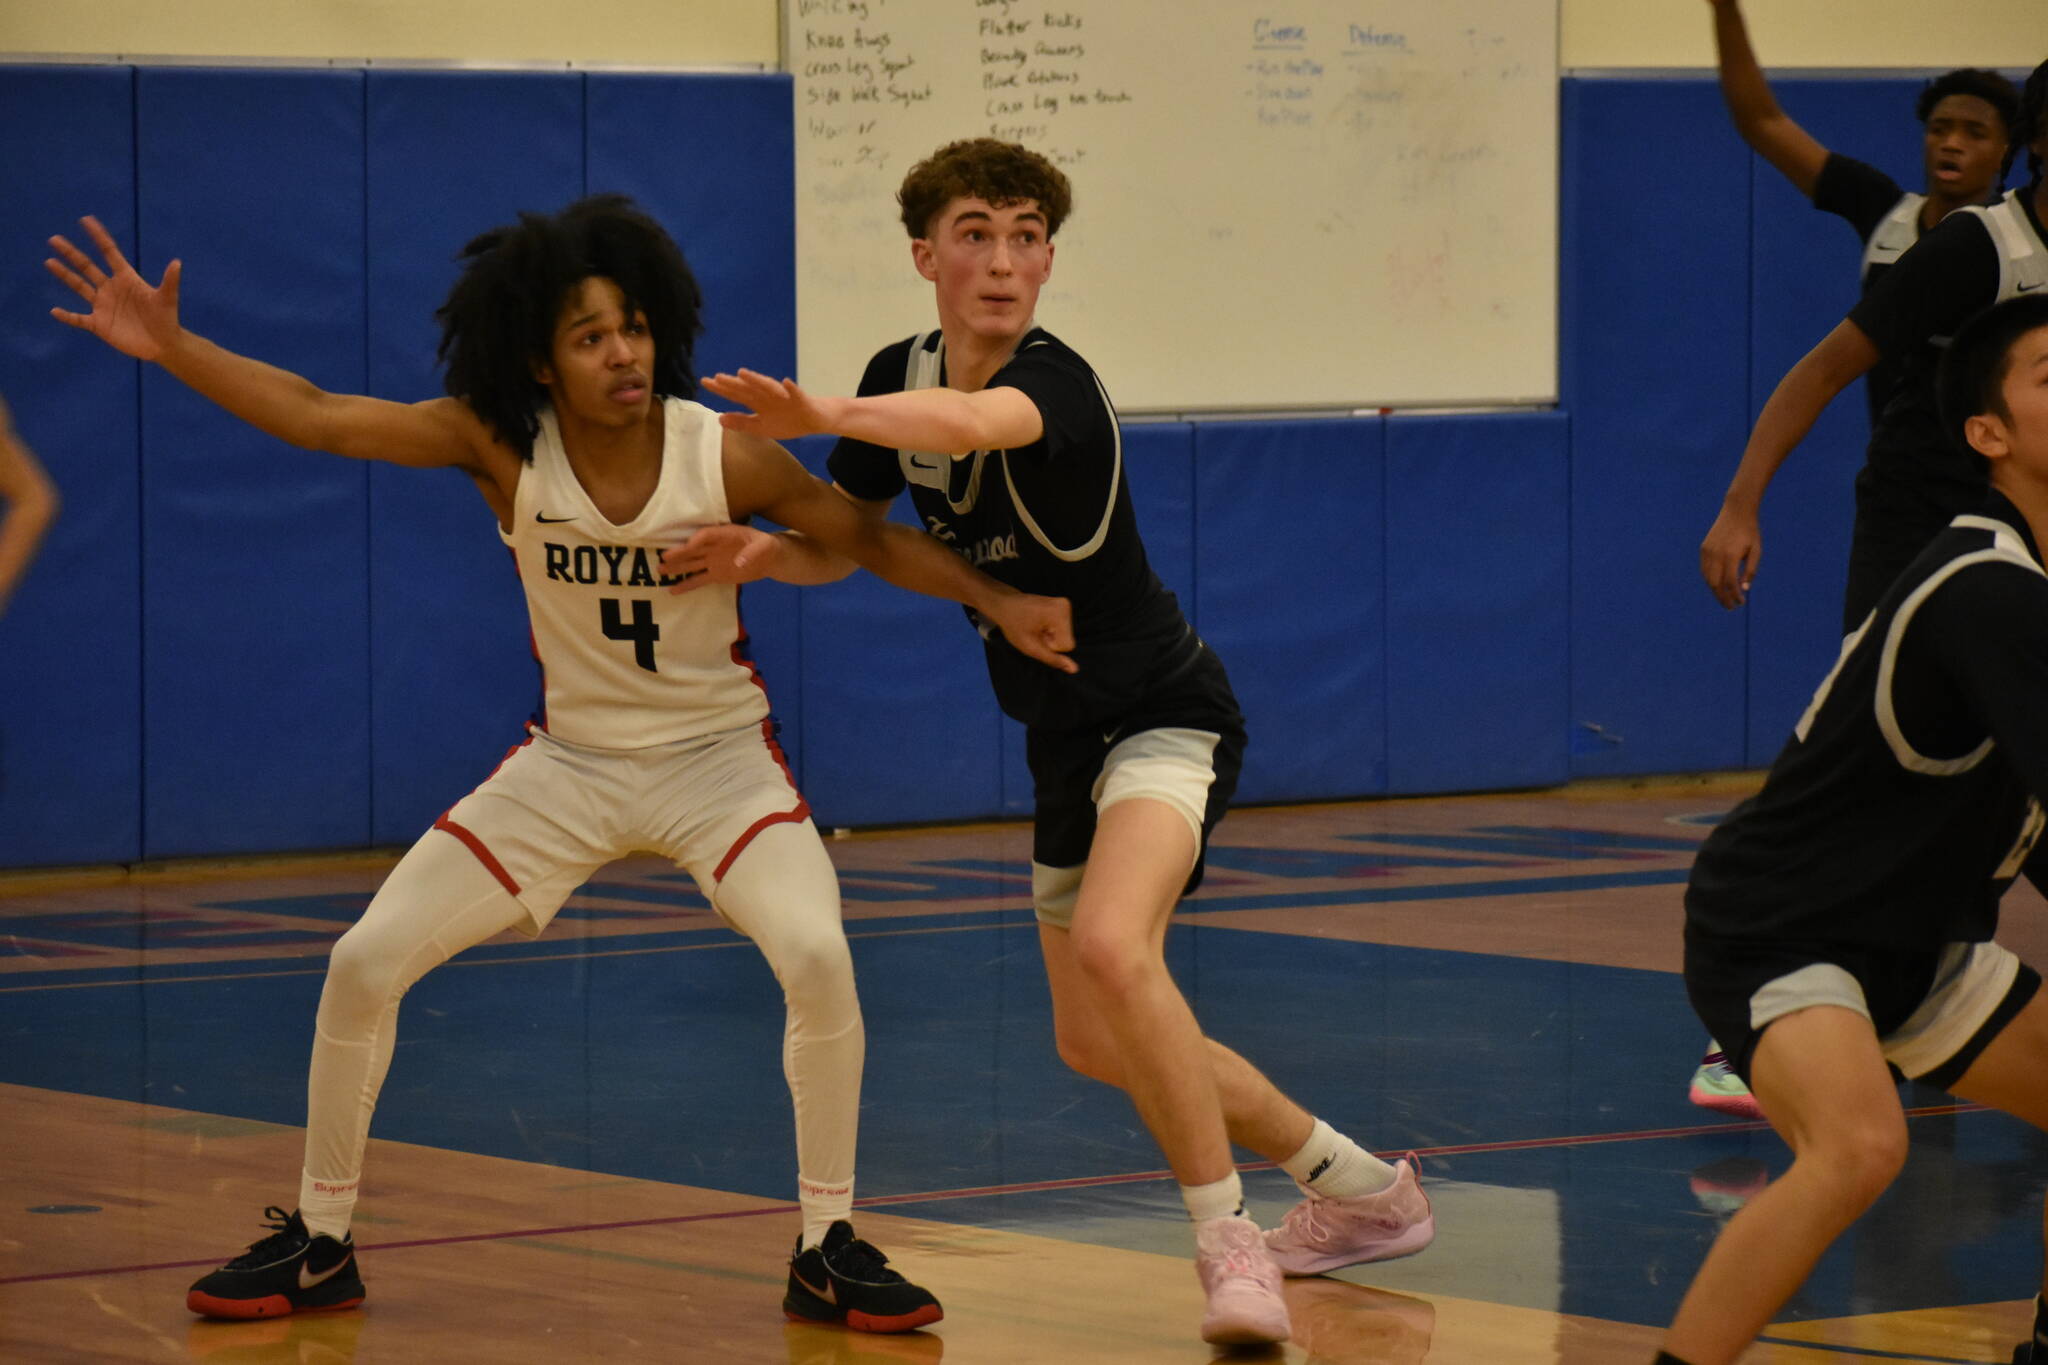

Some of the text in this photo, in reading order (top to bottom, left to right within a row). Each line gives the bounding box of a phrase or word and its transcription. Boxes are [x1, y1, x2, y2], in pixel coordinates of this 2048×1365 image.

[805, 29, 845, 51] Knee
[544, 542, 707, 587] ROYAL
[599, 598, 660, 673] 4
